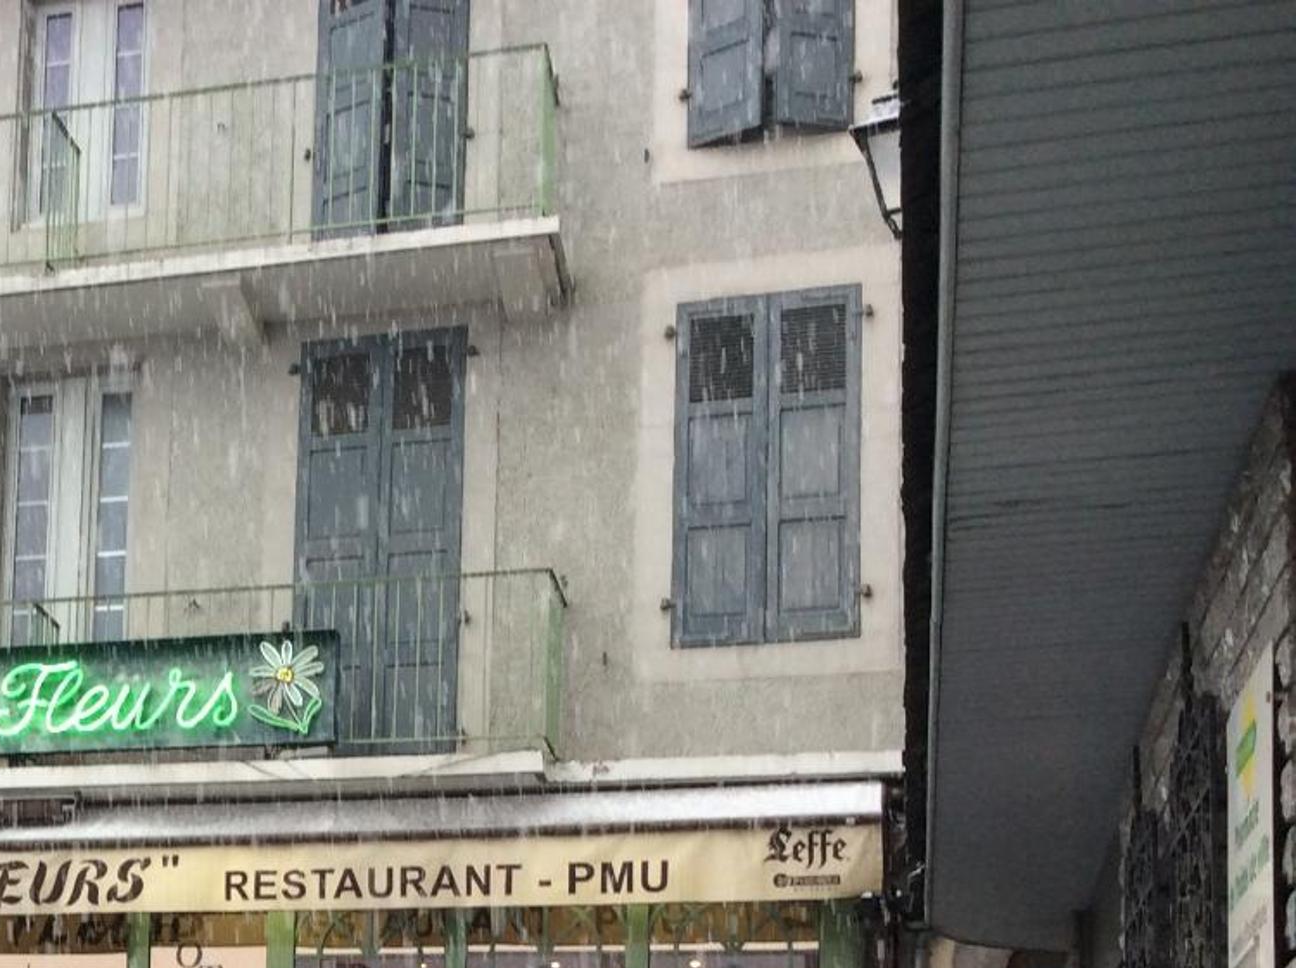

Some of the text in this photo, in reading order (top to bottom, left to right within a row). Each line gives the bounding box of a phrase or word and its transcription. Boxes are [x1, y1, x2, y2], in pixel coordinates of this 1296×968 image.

[764, 825, 847, 869] Leffe
[224, 862, 523, 902] RESTAURANT
[567, 859, 670, 896] PMU
